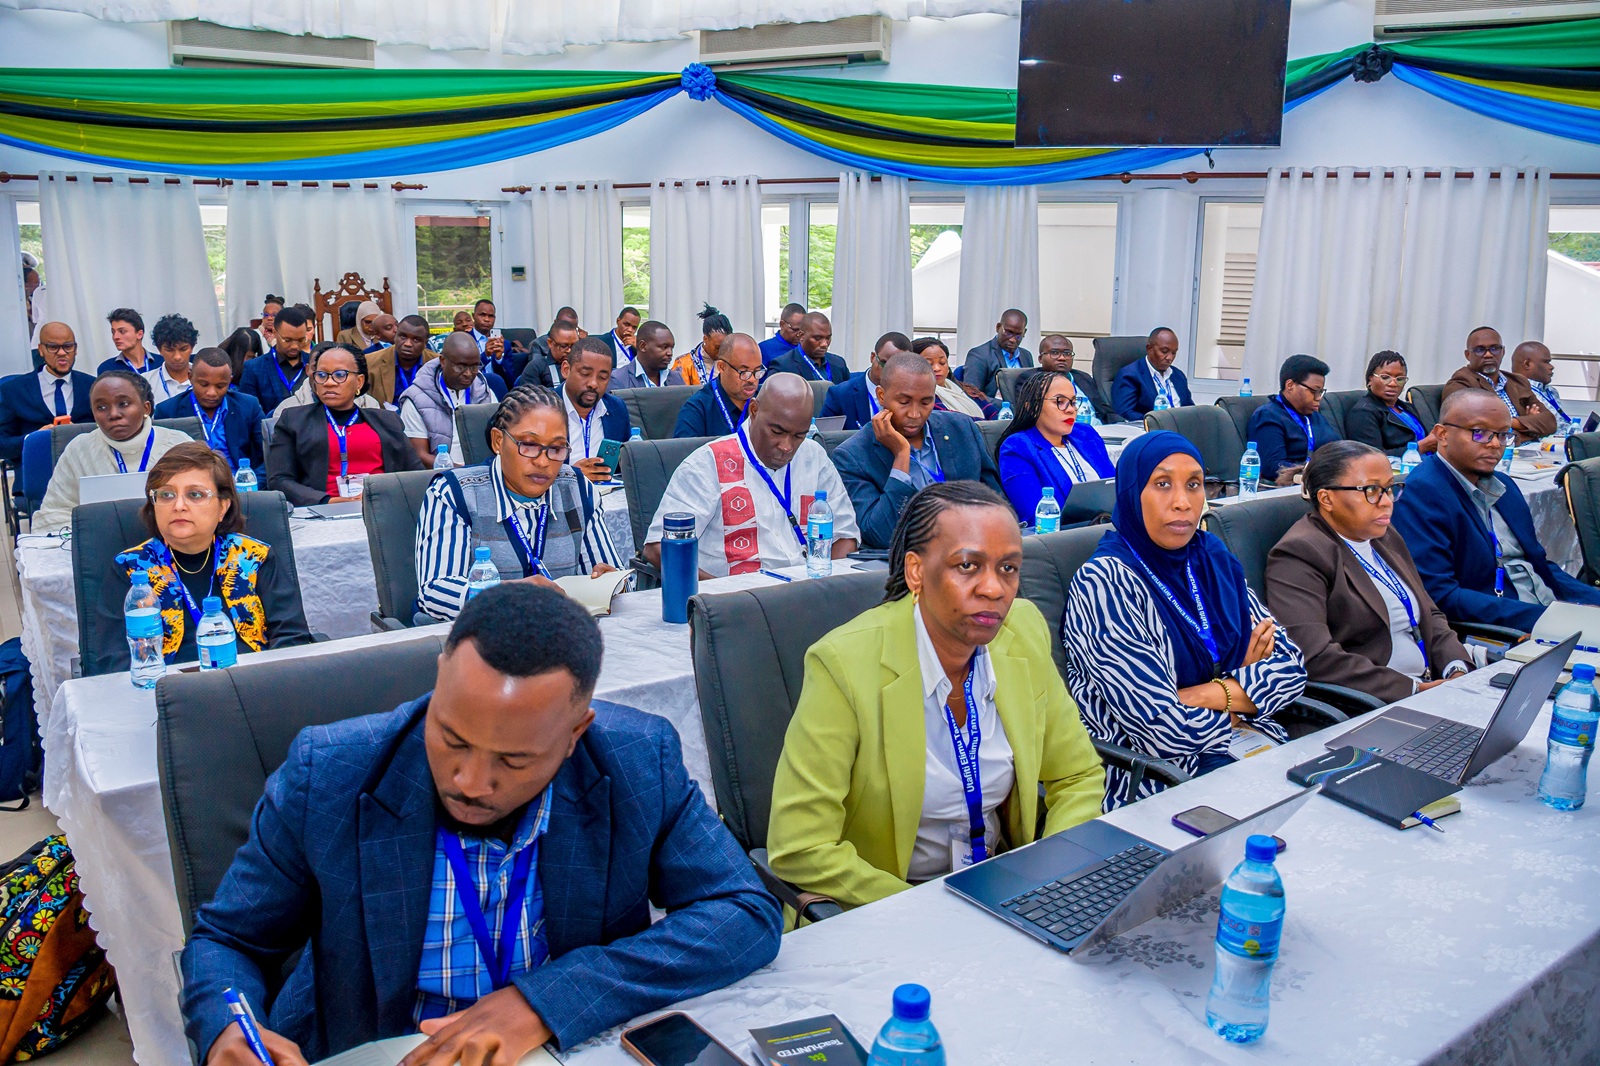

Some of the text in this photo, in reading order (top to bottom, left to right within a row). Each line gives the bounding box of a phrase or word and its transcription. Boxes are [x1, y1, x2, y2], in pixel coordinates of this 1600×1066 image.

[968, 695, 979, 735] Tanzania
[957, 740, 969, 766] Elimu
[969, 737, 979, 760] Elimu
[962, 765, 975, 793] Utafiti
[776, 1038, 844, 1058] TeachUNITED
